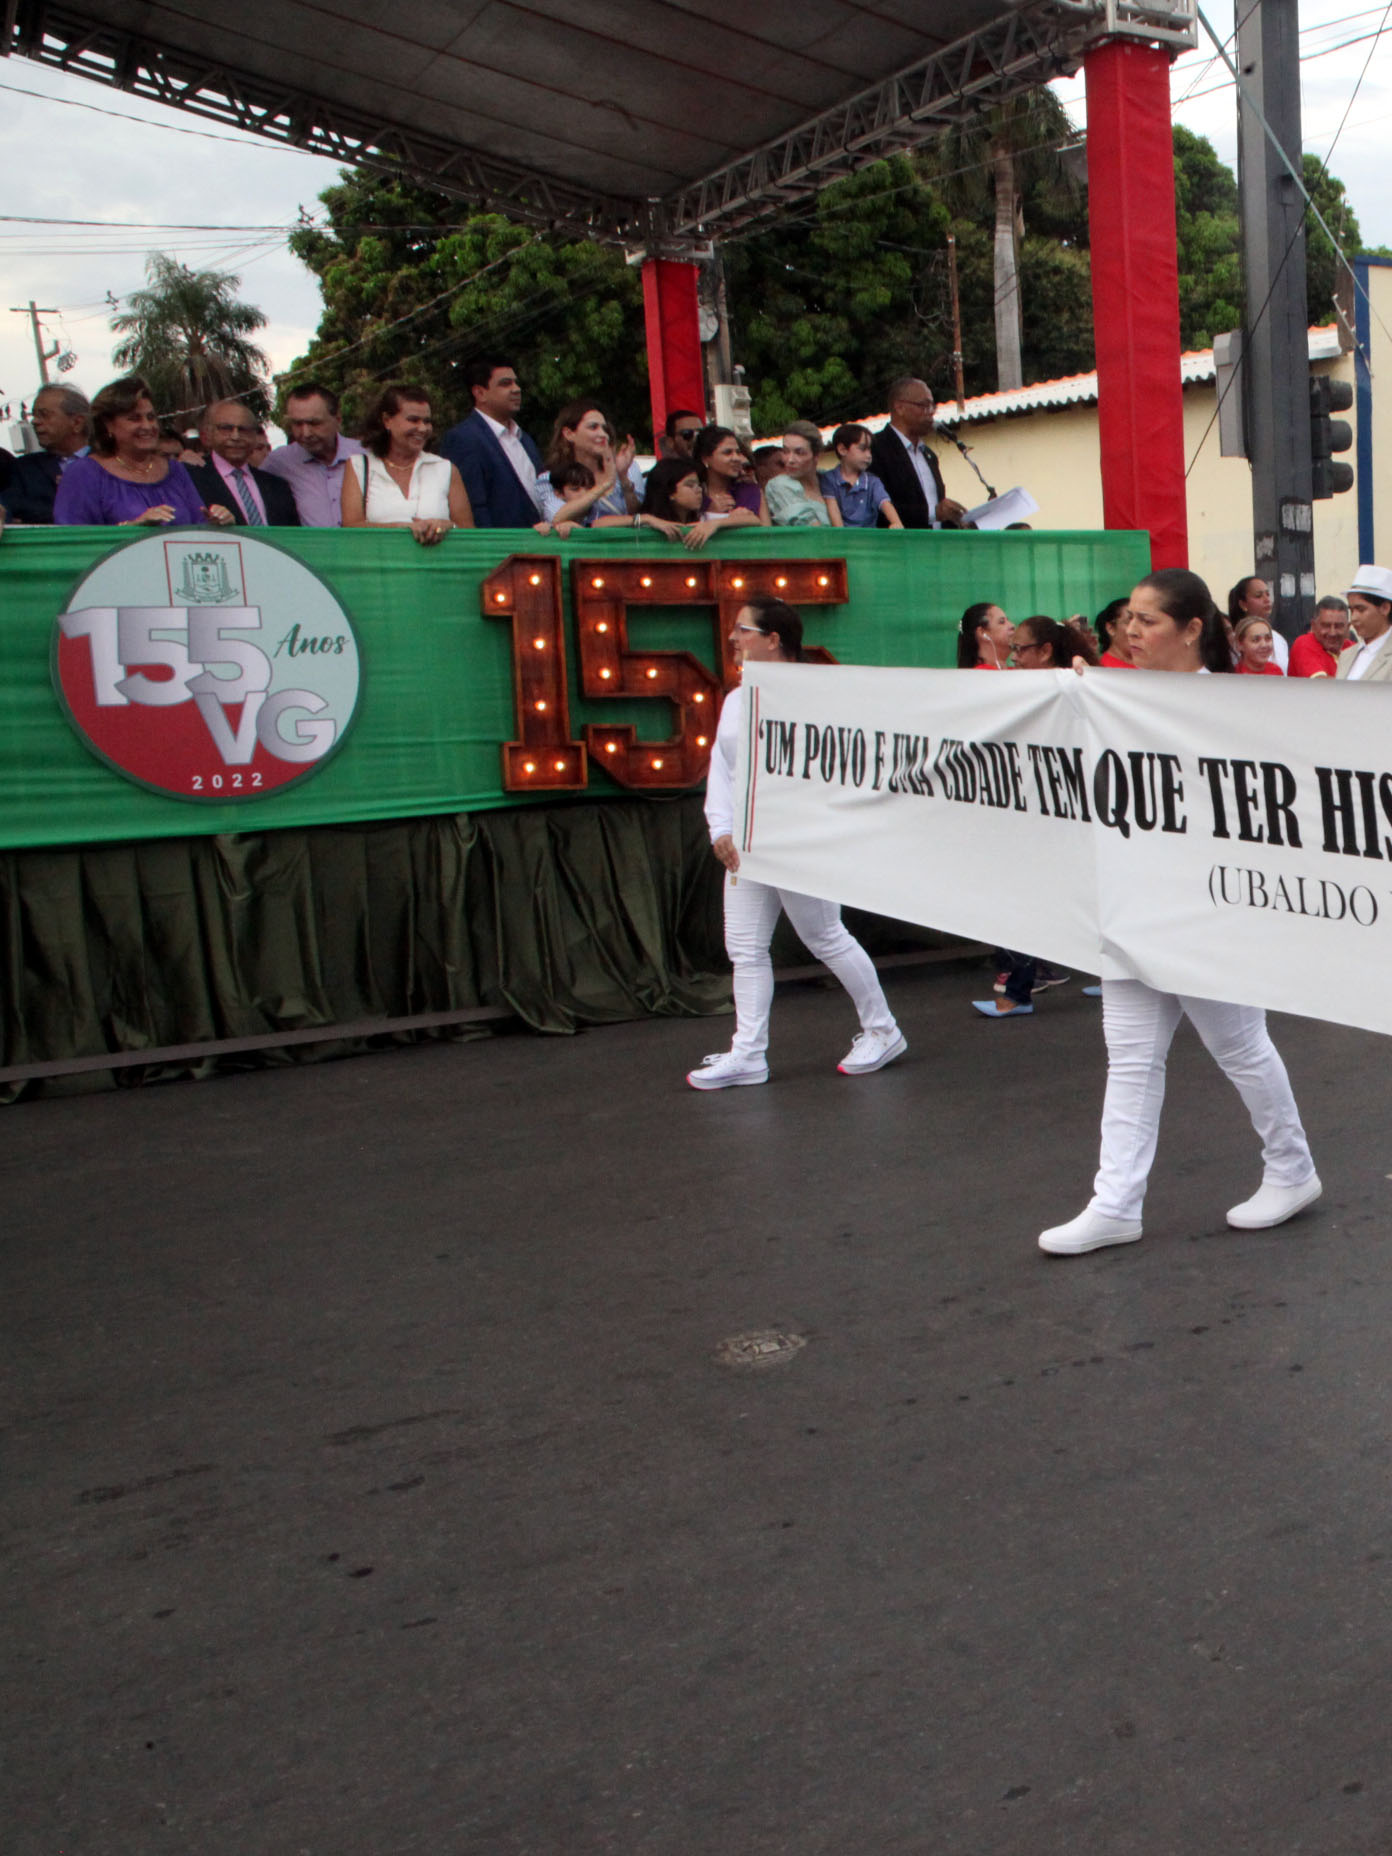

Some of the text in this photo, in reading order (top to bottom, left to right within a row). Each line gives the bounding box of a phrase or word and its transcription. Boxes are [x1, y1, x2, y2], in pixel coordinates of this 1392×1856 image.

[57, 606, 273, 707] 155
[274, 623, 350, 659] Anos
[194, 688, 337, 766] VG
[191, 772, 263, 790] 2022
[802, 723, 867, 788] POVO
[871, 730, 886, 791] E
[888, 732, 935, 797] UMA
[933, 738, 1028, 812] CIDADE
[1027, 743, 1092, 823] TEM
[1094, 748, 1188, 839] QUE
[1198, 756, 1303, 849] TER
[1208, 864, 1379, 927] (UBALDO
